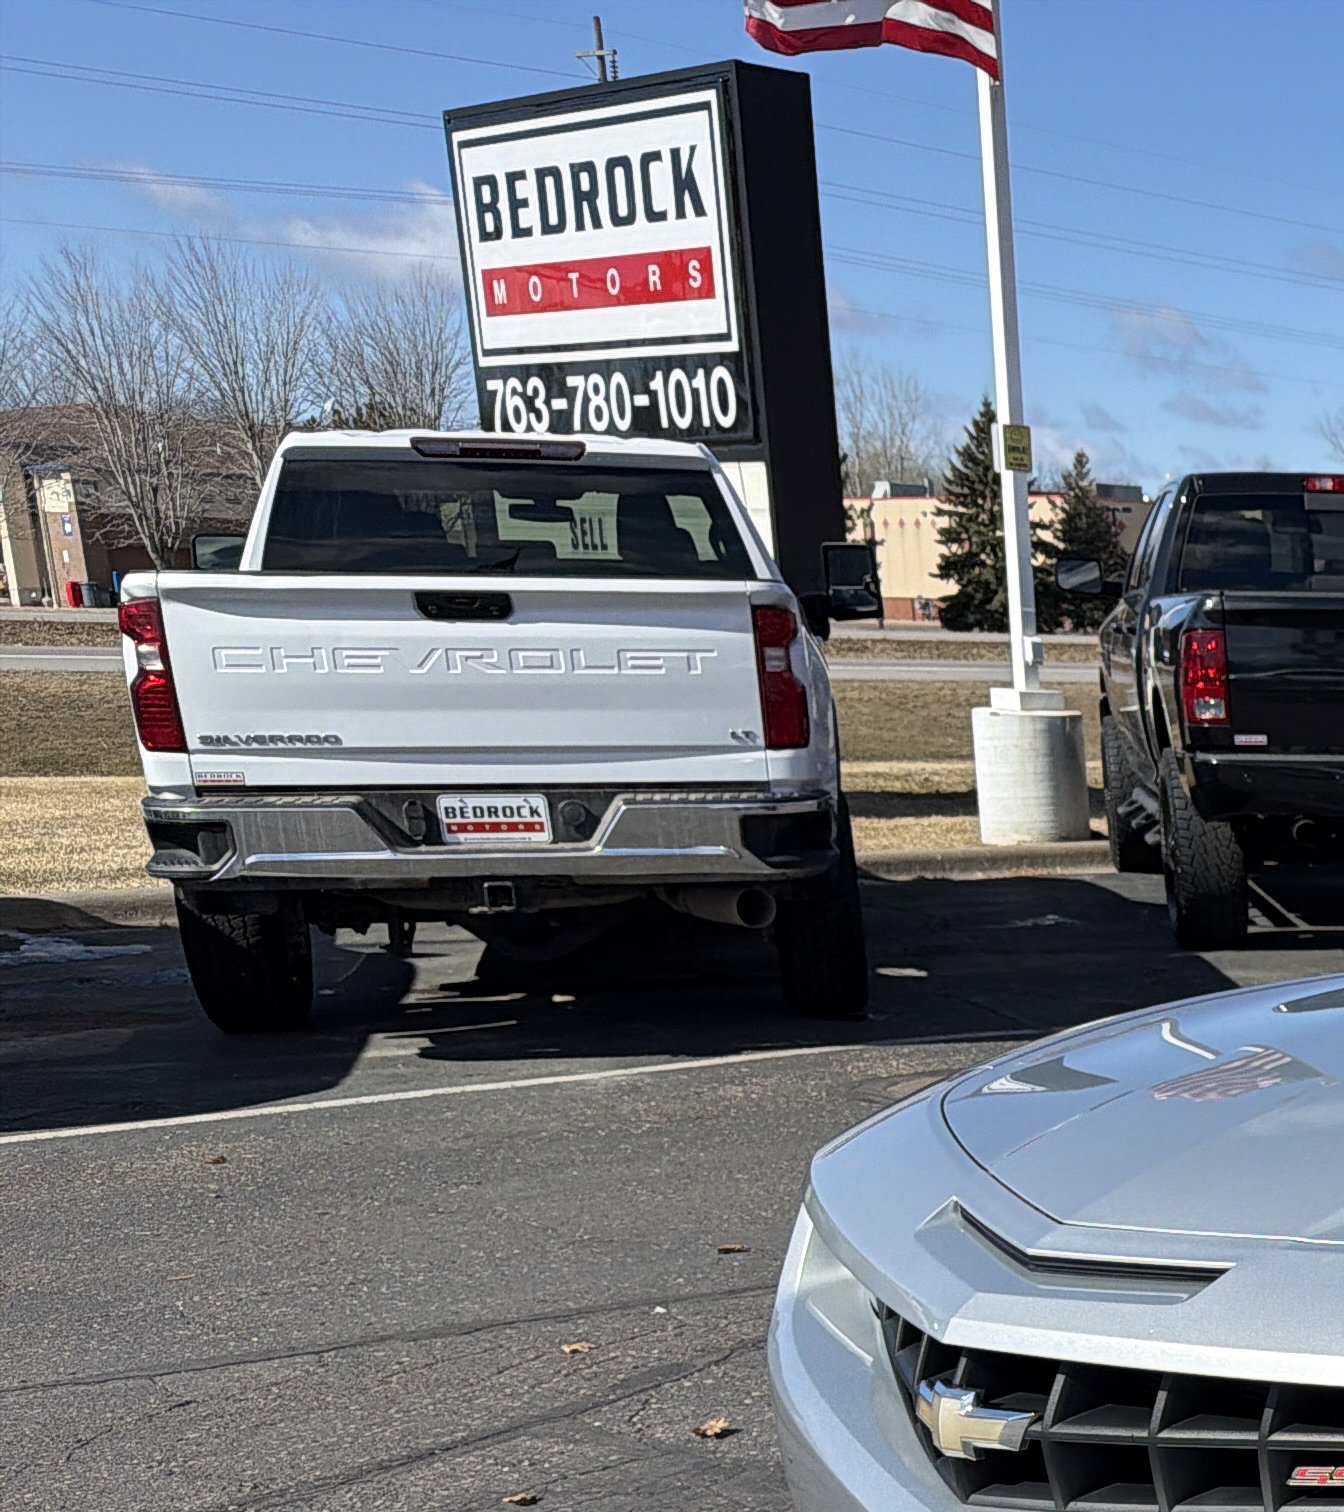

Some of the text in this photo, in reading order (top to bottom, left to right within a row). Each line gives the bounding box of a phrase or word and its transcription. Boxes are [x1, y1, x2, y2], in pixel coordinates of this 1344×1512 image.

[472, 144, 708, 243] BEDROCK
[492, 258, 702, 305] MOTORS
[486, 365, 737, 433] 763-780-1010
[570, 517, 608, 551] SELL
[211, 646, 718, 674] CHEVROLET
[196, 733, 343, 748] SILVERADO
[444, 805, 543, 820] BEDROCK
